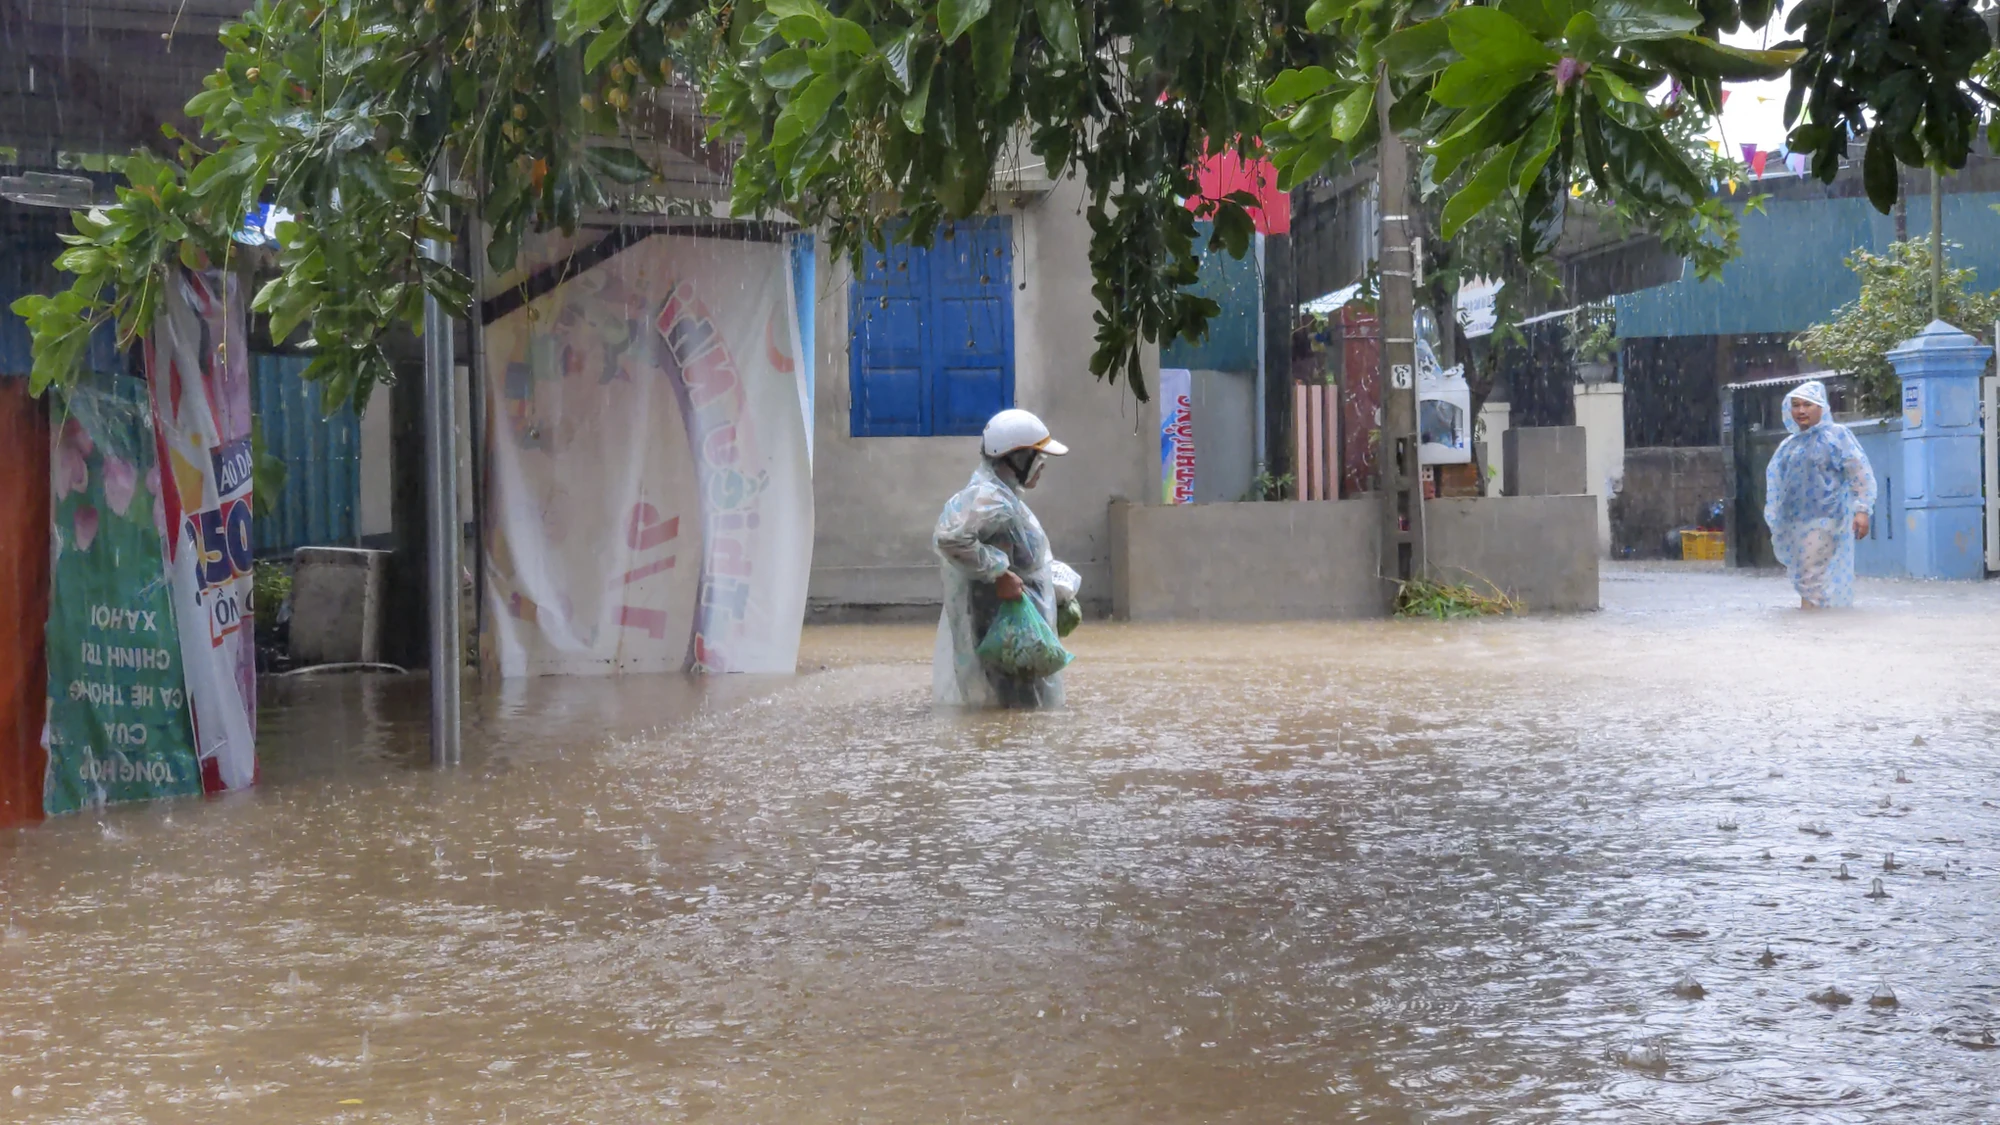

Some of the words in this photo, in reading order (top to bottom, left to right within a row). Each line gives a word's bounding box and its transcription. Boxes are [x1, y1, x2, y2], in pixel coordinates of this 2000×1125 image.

[220, 456, 238, 492] ÁO
[108, 645, 170, 672] CHÍNH
[131, 682, 153, 709] HỆ
